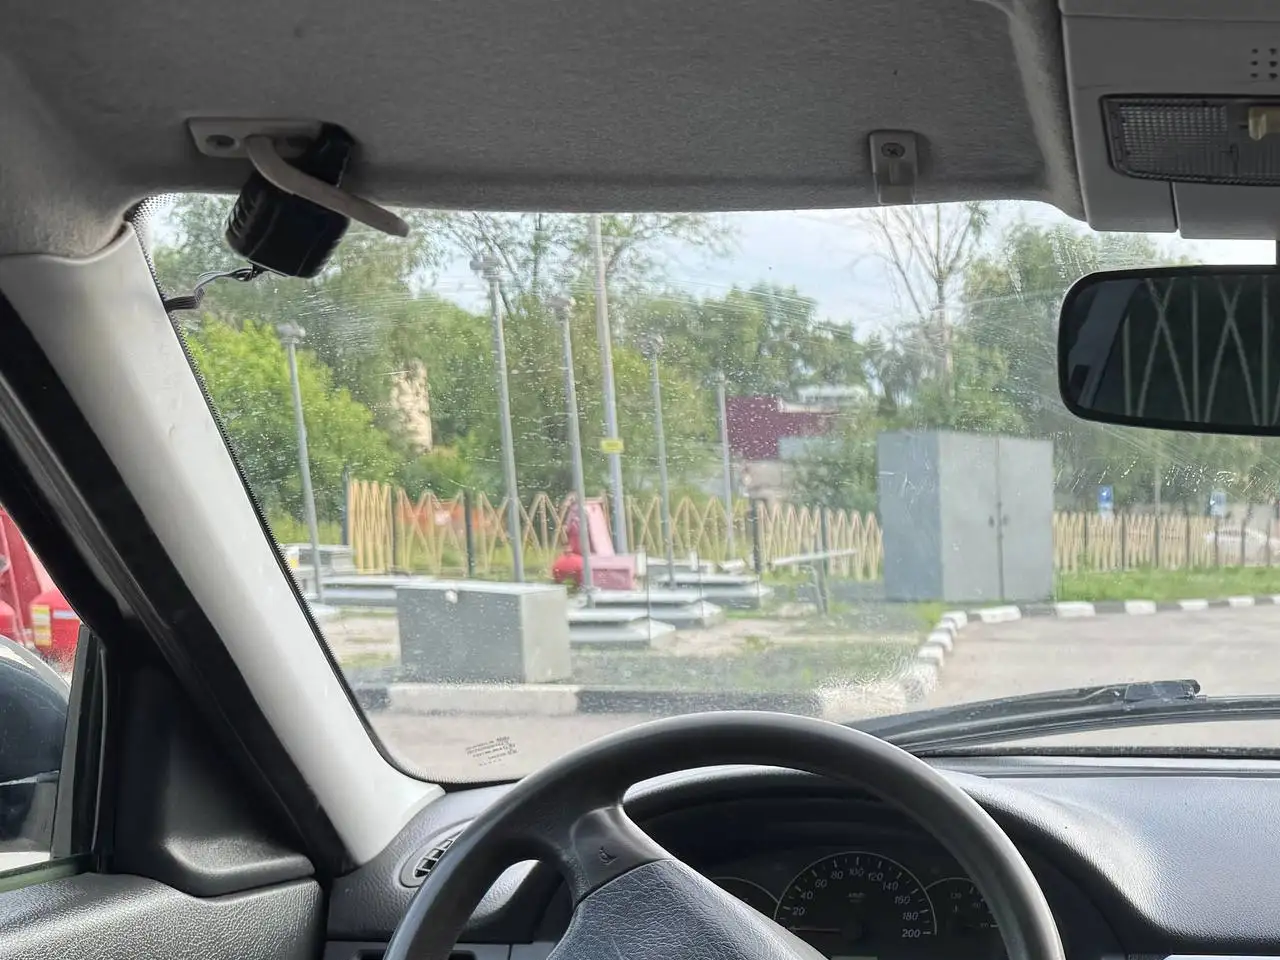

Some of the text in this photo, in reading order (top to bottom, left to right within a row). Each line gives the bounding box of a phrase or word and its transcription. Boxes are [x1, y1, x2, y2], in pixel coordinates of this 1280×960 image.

[830, 870, 843, 880] 80
[849, 867, 864, 877] 100
[868, 872, 884, 882] 120
[814, 879, 828, 889] 60
[882, 881, 899, 891] 140
[801, 891, 814, 900] 40
[894, 895, 911, 905] 160
[792, 906, 805, 916] 20
[902, 912, 919, 921] 180
[902, 928, 921, 938] 200
